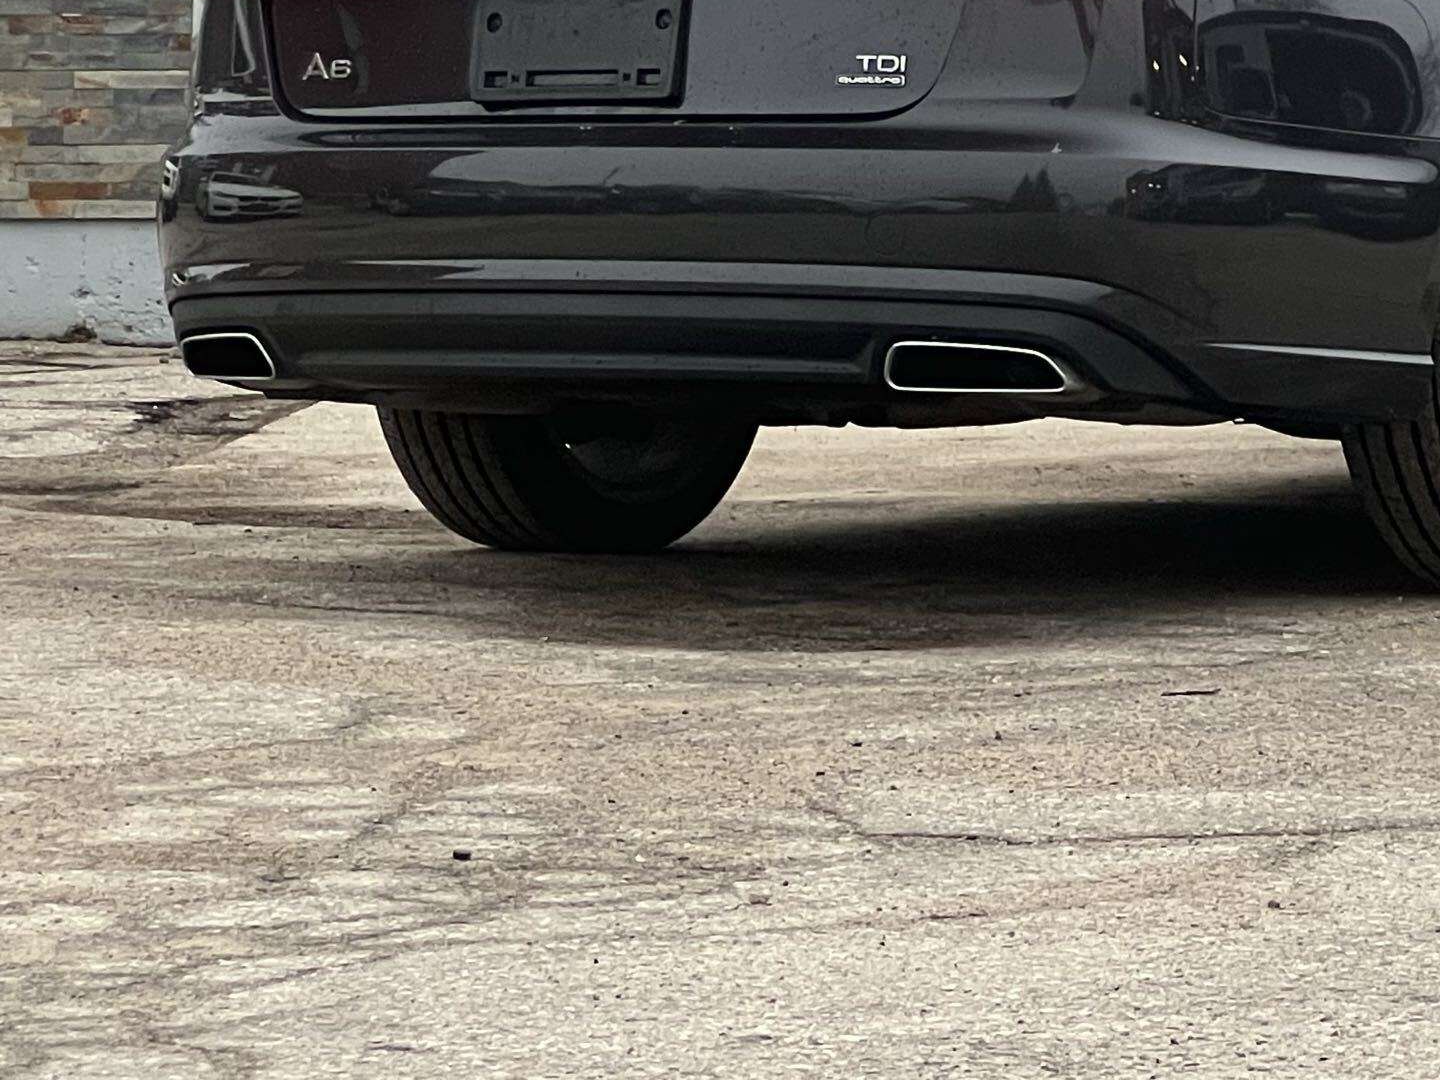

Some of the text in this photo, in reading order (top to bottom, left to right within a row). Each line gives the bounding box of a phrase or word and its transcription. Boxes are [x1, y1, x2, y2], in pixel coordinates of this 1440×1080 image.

[302, 52, 352, 81] A6
[855, 54, 907, 73] TDI
[837, 75, 903, 85] quattro
